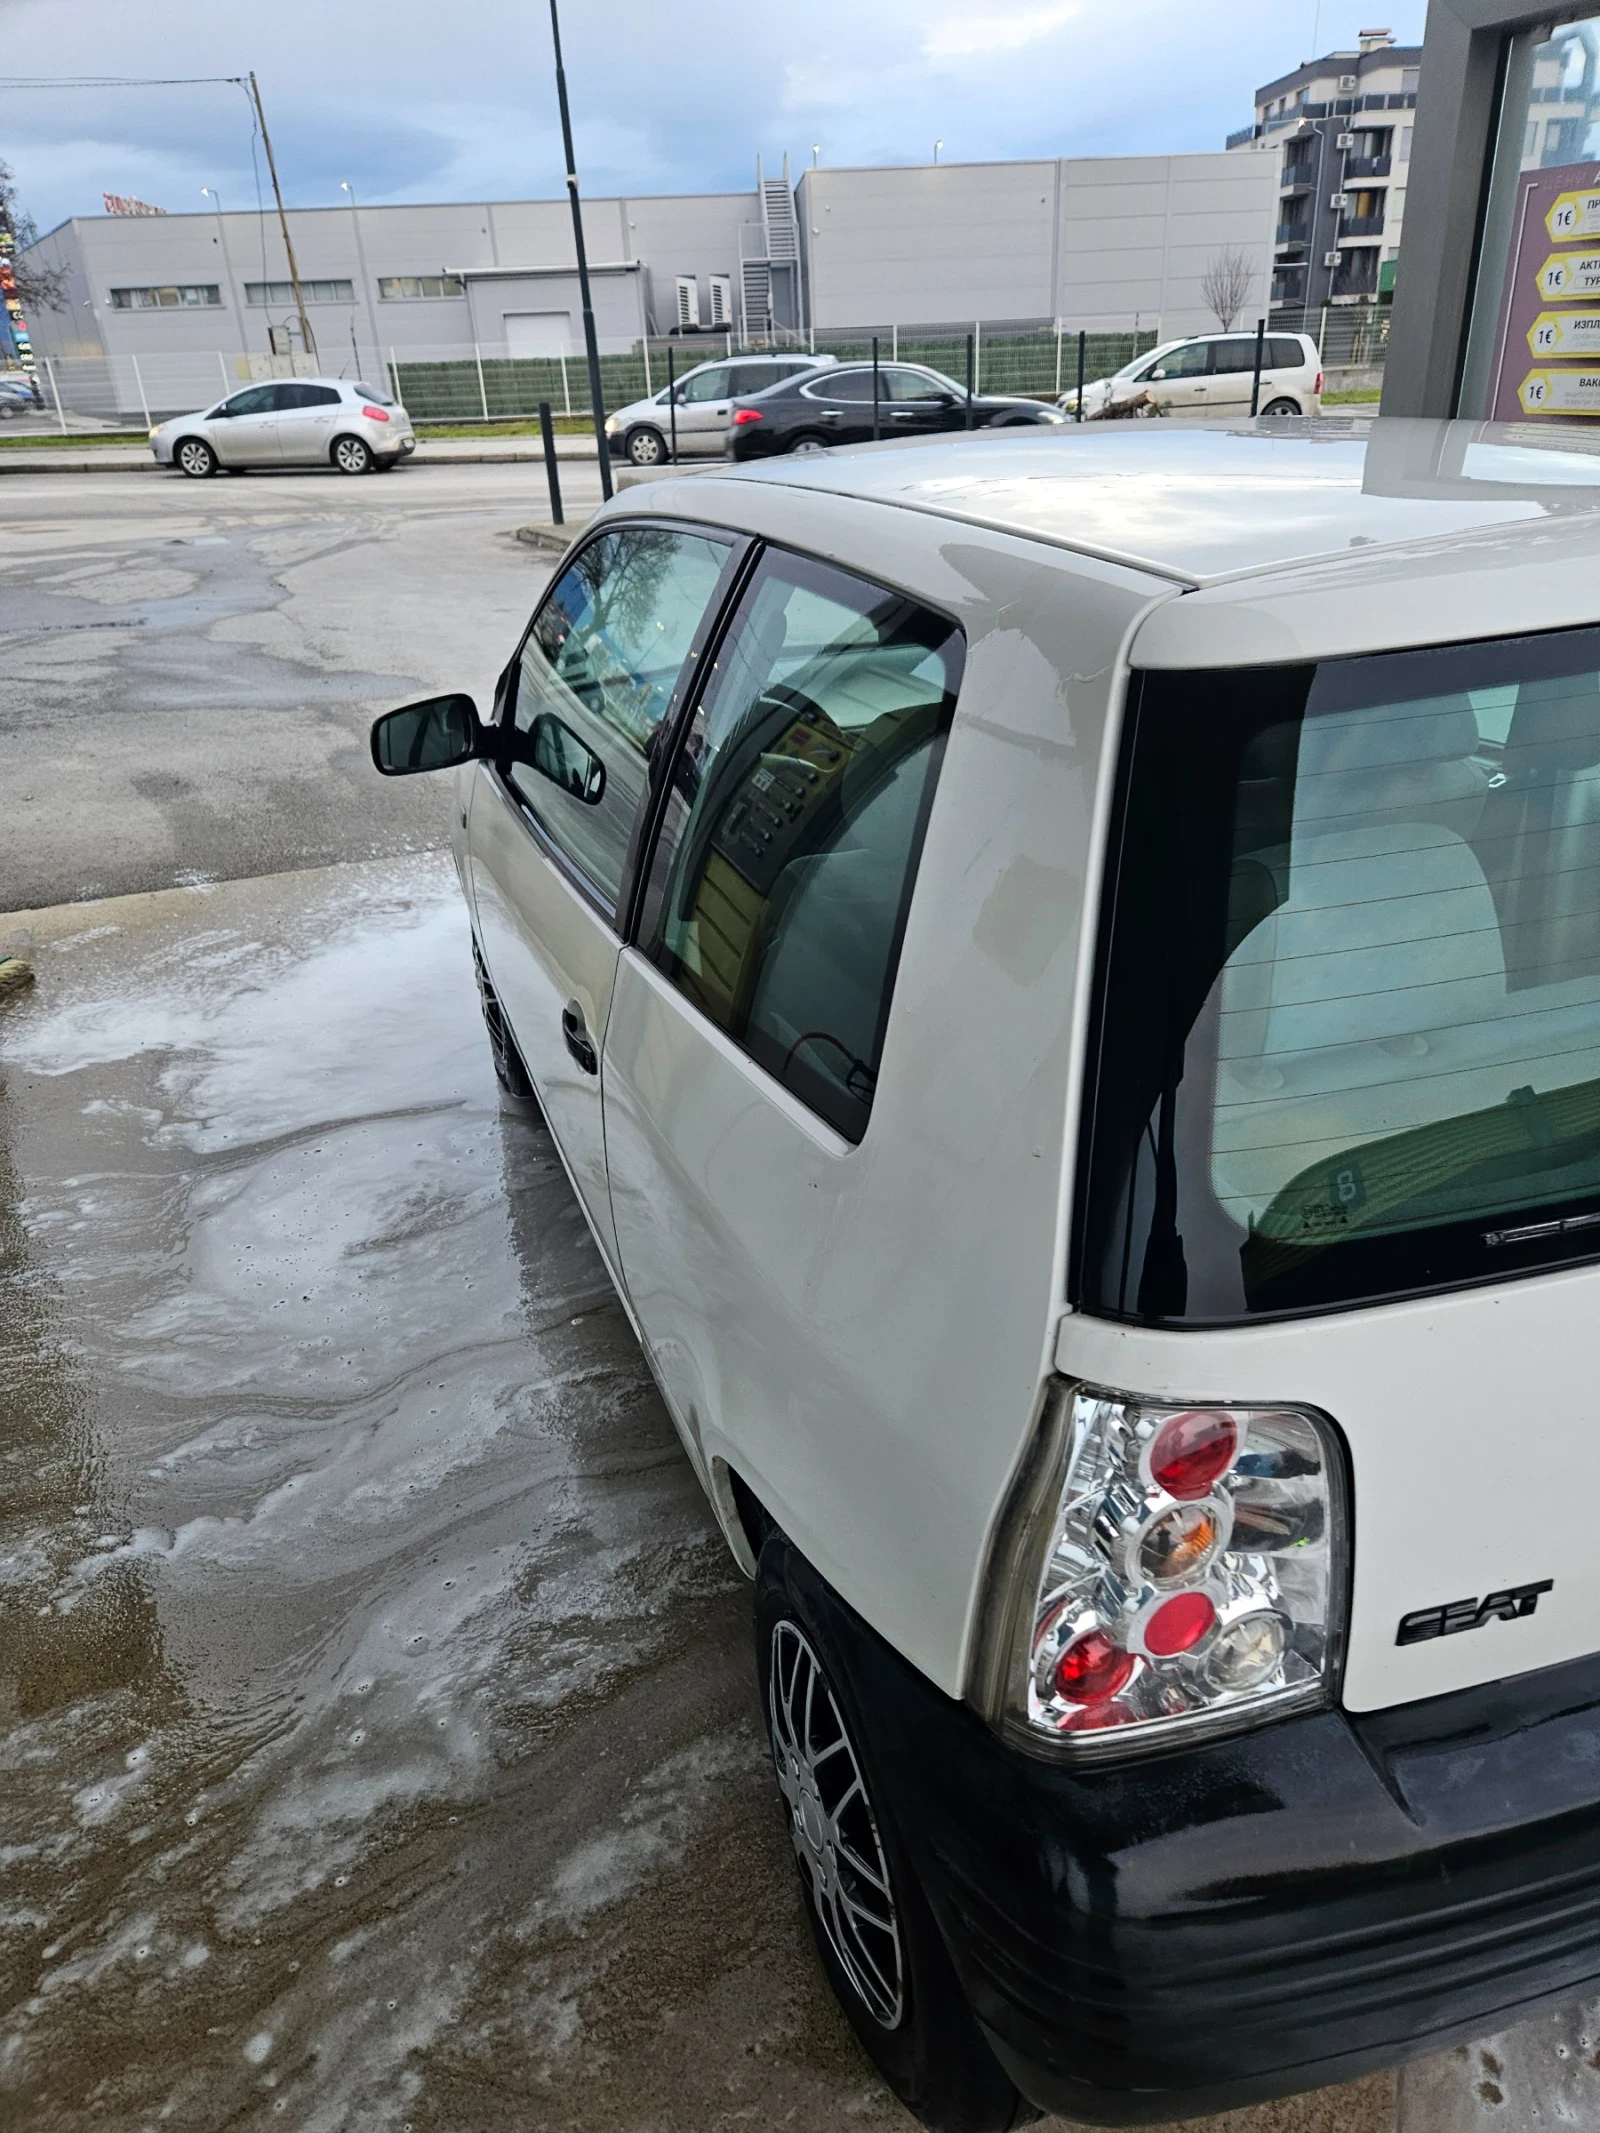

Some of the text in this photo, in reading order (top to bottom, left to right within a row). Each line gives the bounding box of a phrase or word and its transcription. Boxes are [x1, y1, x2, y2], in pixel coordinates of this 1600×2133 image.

[1557, 210, 1572, 226] 1€
[1579, 260, 1600, 270] АКТ
[1548, 271, 1563, 285] 1€
[1538, 329, 1553, 344] 1€
[1528, 386, 1543, 399] 1€
[1395, 1578, 1554, 1646] SEAT
